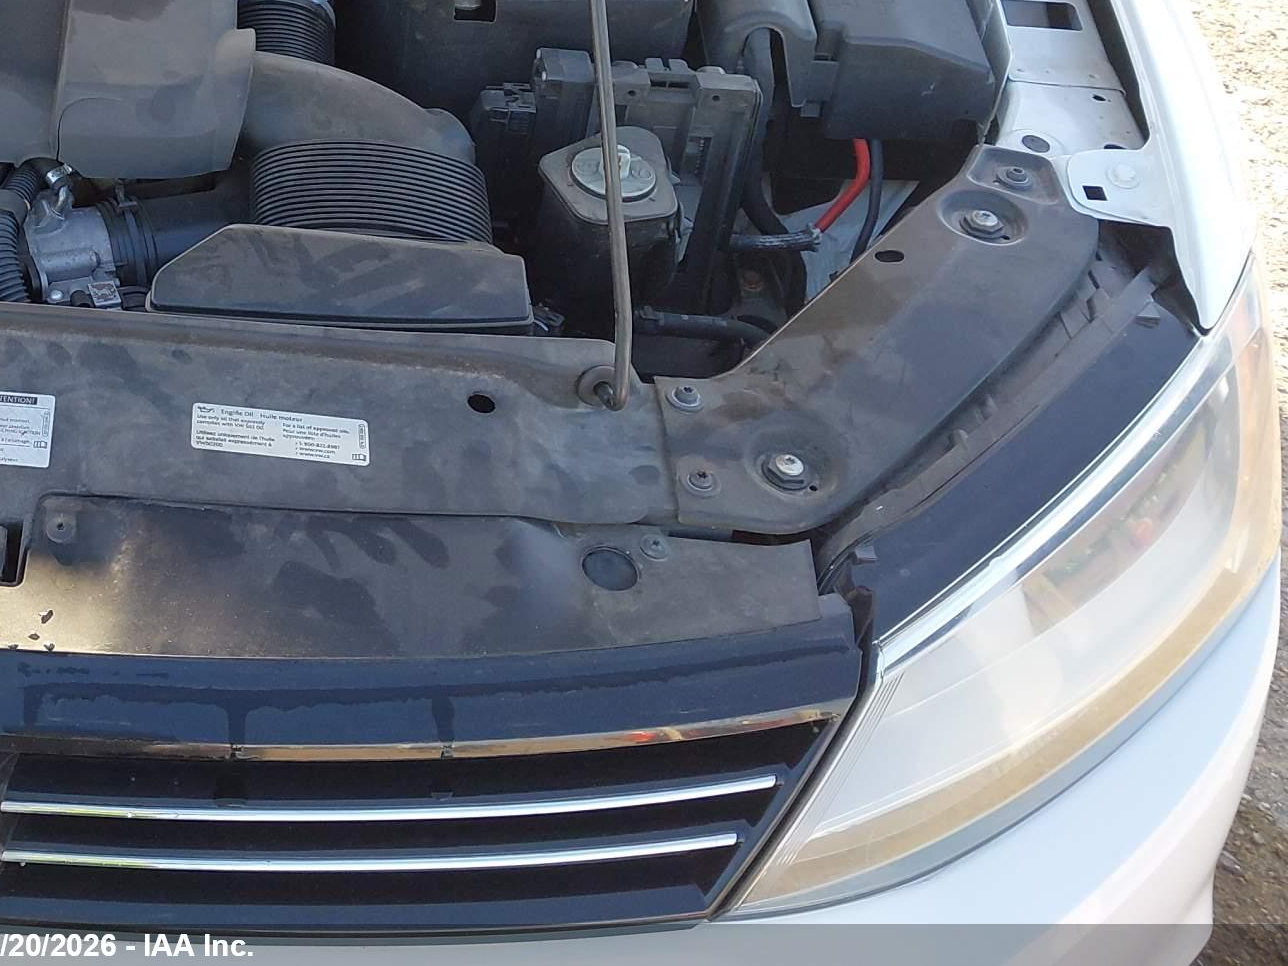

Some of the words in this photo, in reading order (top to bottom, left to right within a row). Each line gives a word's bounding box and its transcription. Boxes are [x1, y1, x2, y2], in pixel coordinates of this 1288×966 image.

[221, 408, 243, 417] Engine
[260, 412, 276, 420] Huile
[278, 414, 302, 423] moteur
